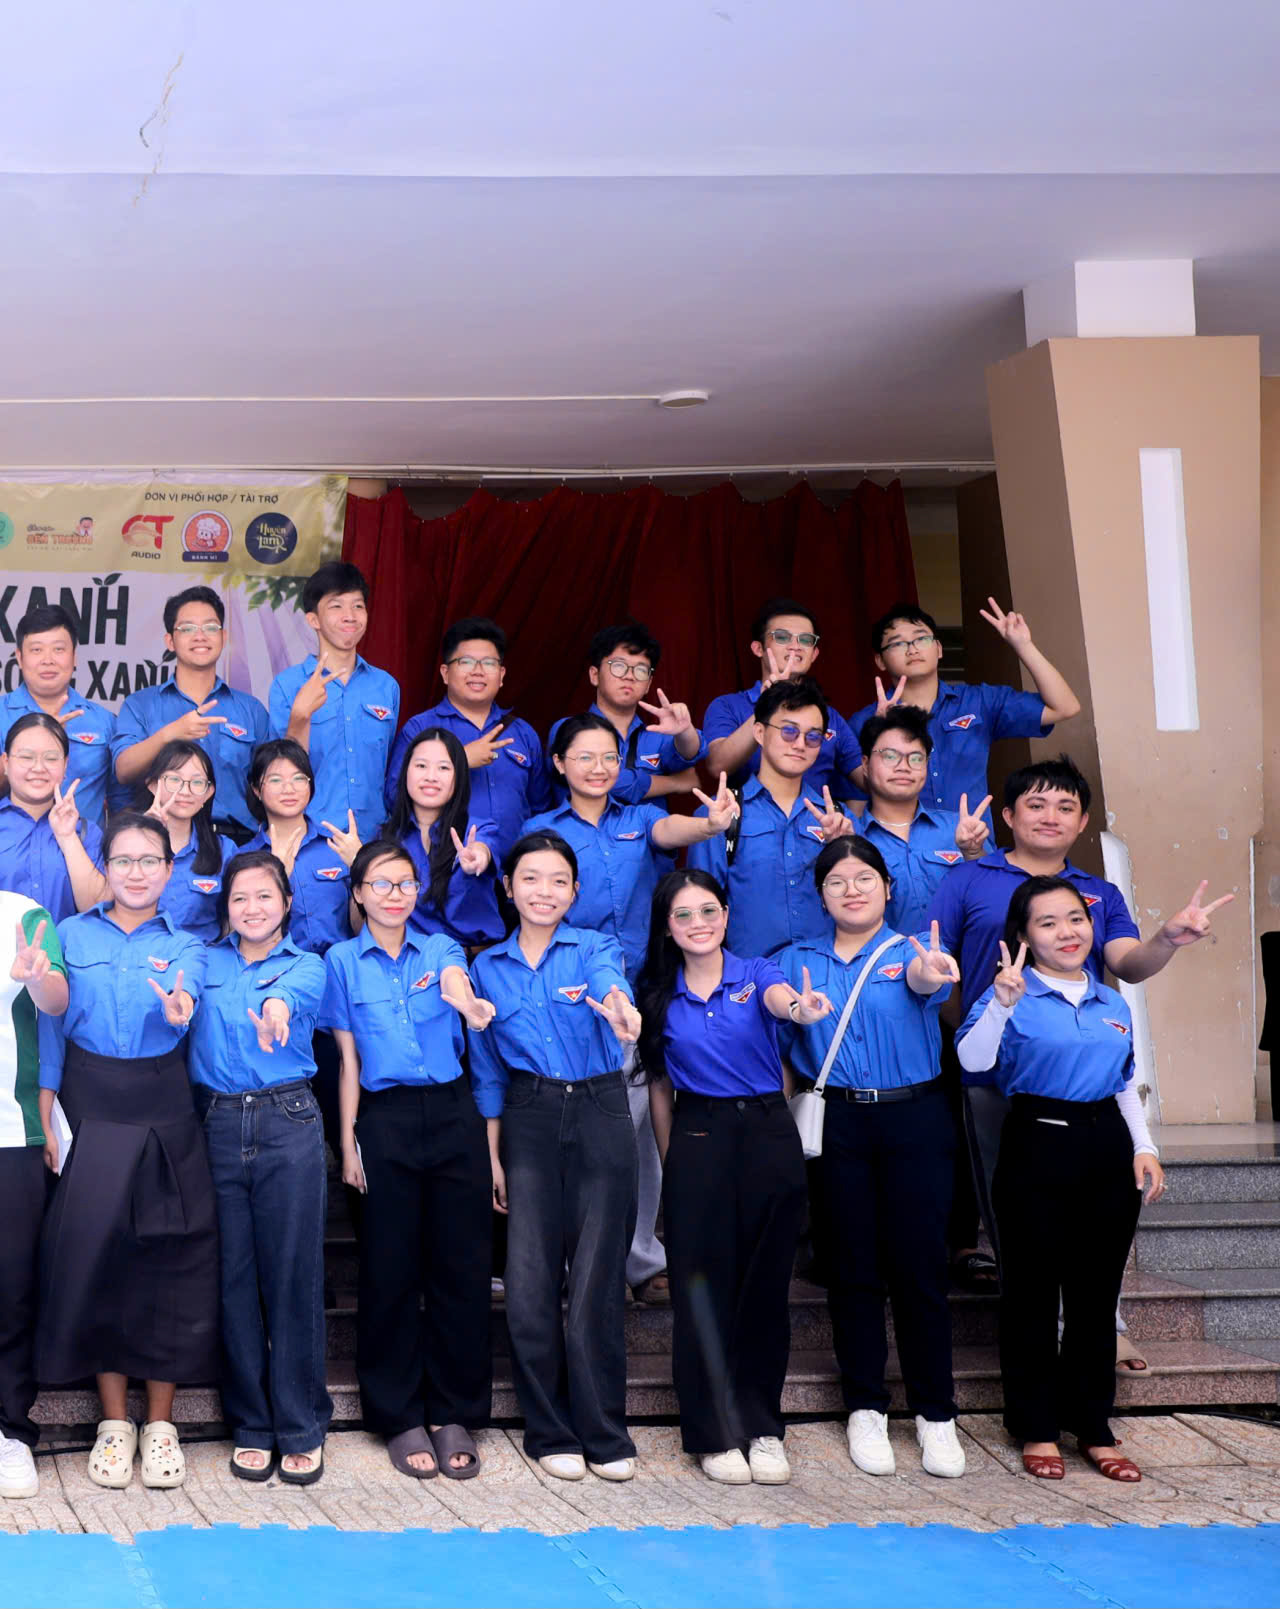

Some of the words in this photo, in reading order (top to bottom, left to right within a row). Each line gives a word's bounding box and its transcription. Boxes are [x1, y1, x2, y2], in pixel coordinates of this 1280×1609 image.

[207, 493, 229, 504] HỢP
[230, 493, 238, 504] /
[239, 492, 255, 503] TÀI
[131, 551, 161, 559] AUDIO
